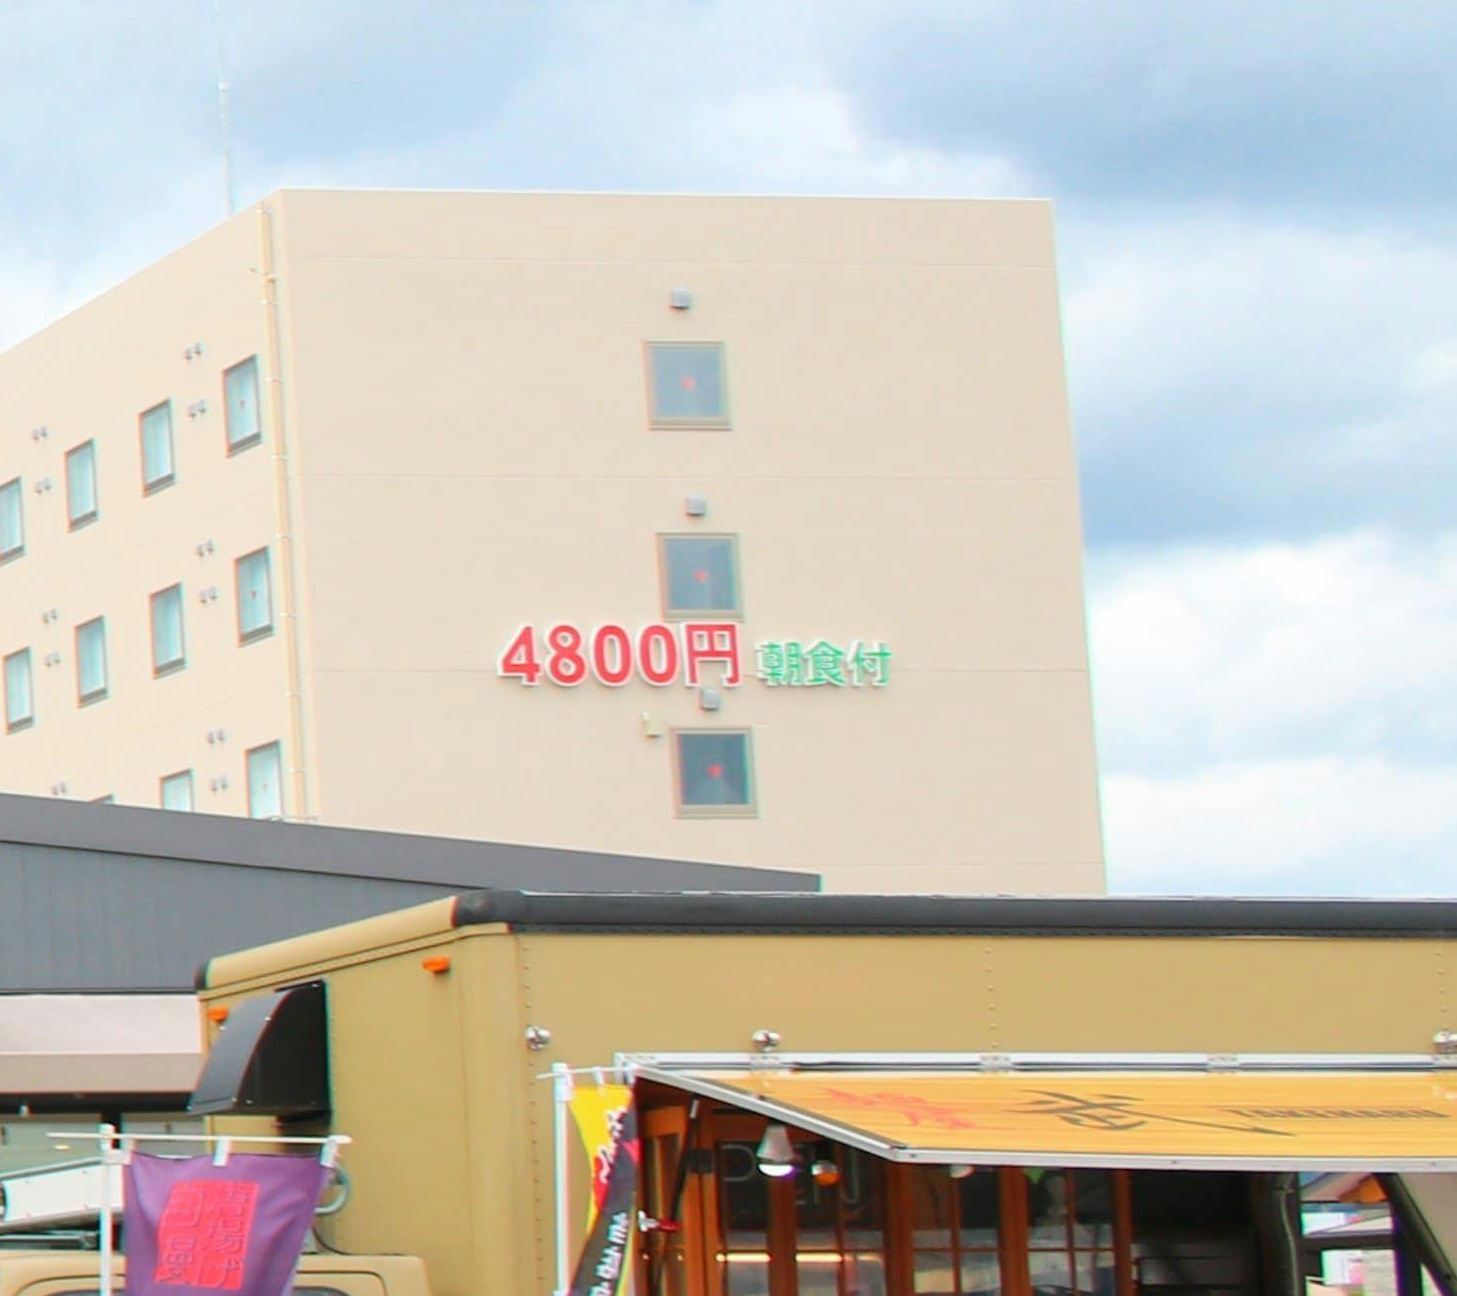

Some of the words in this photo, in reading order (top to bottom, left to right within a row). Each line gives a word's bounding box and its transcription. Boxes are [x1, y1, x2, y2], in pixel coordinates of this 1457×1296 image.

[498, 621, 742, 689] 4800円
[755, 637, 892, 687] 朝食付
